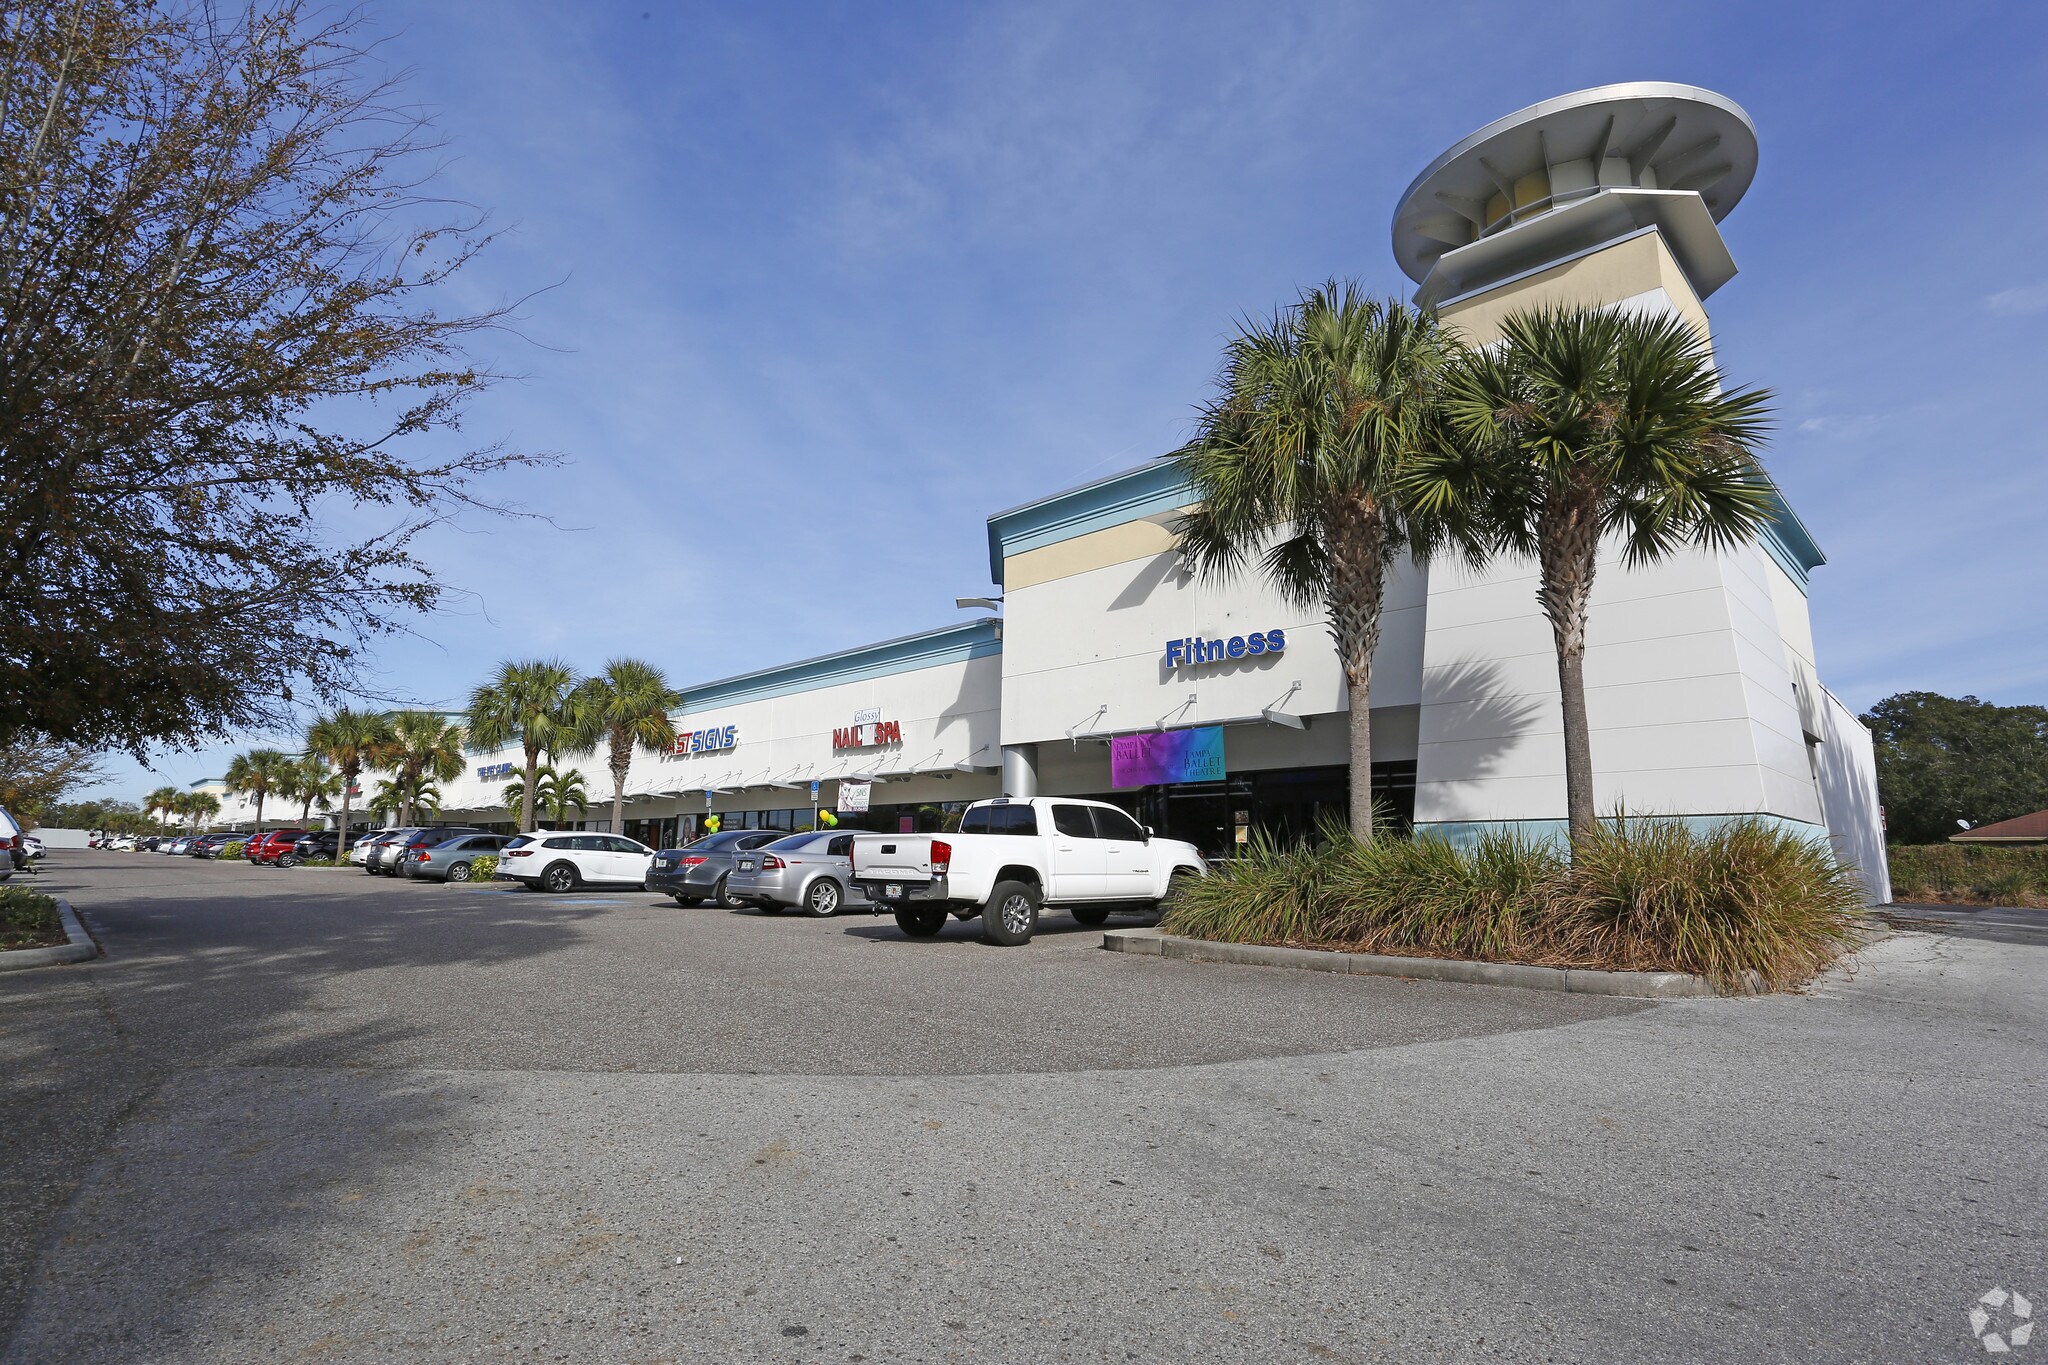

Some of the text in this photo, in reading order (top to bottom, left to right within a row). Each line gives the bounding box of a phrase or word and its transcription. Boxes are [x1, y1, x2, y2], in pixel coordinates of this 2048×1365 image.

[1166, 629, 1286, 669] Fitness
[854, 711, 880, 723] Glossy
[833, 720, 901, 749] NAIL SPA
[1116, 747, 1152, 760] BALLET
[1185, 749, 1211, 759] TAMPA
[1184, 756, 1222, 769] BALLET
[1185, 767, 1222, 777] THEATRE
